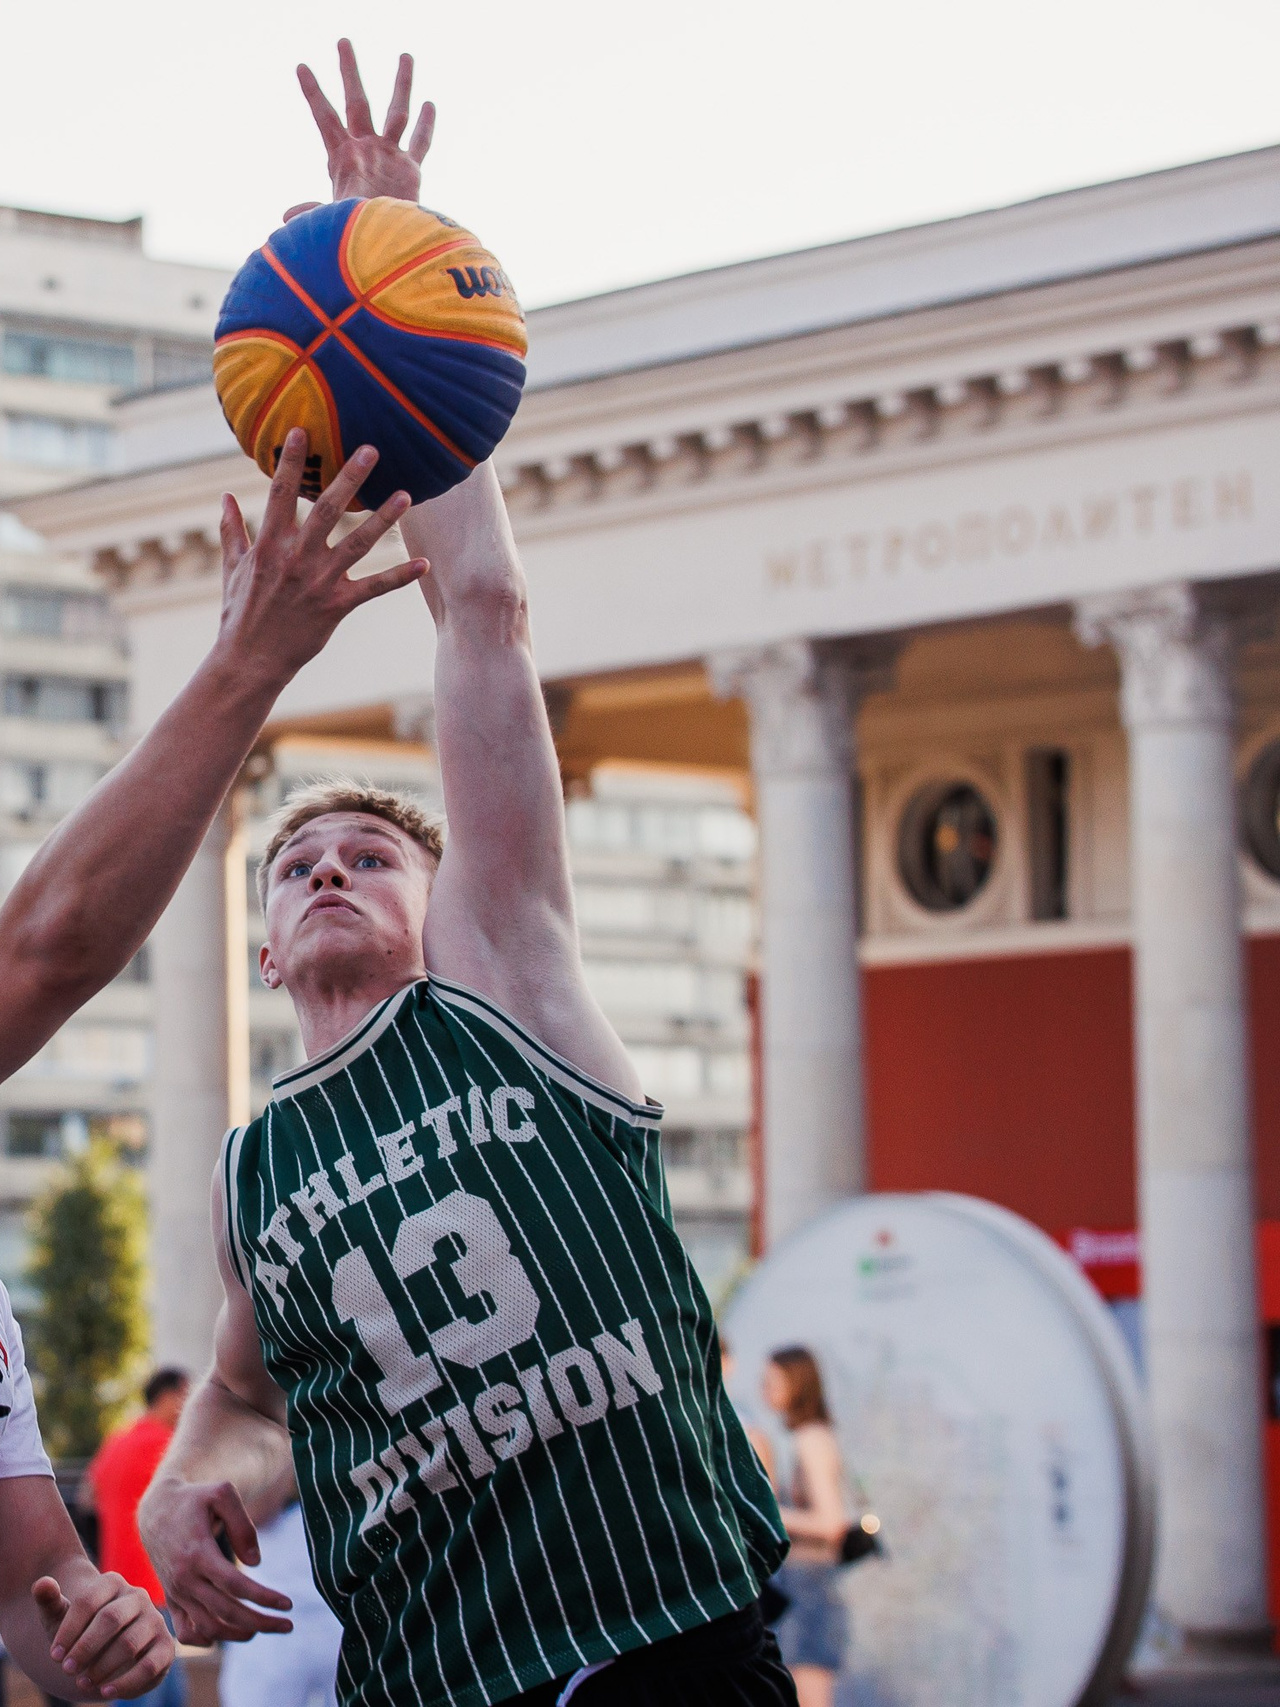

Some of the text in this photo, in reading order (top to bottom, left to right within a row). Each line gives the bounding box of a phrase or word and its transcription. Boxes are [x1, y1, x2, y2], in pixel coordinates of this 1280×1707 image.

[764, 468, 1255, 592] МЕТРОПОЛИТЕН
[255, 1085, 537, 1316] ATHLETIC
[331, 1189, 542, 1418] 13
[348, 1317, 664, 1536] DIVISION
